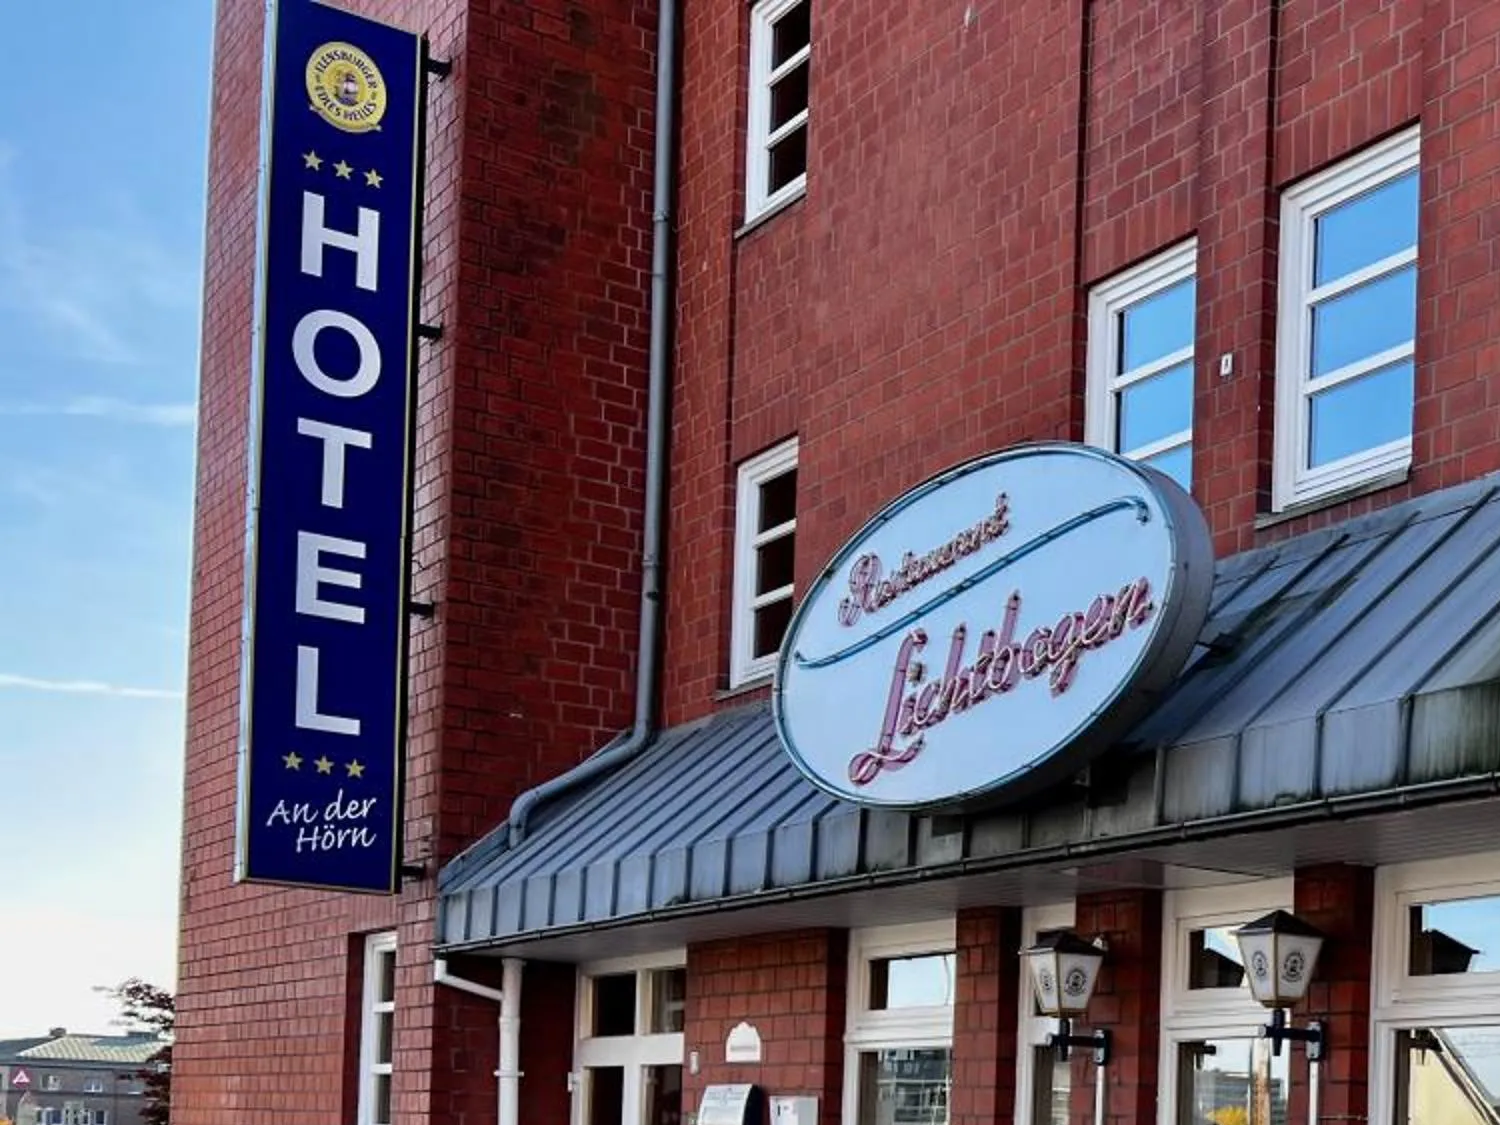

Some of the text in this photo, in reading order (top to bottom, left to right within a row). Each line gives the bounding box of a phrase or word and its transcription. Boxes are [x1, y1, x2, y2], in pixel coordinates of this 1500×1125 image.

[292, 190, 381, 736] HOTEL
[847, 576, 1155, 786] Lichtbogen
[266, 789, 376, 826] An der
[296, 823, 376, 853] Hörn
